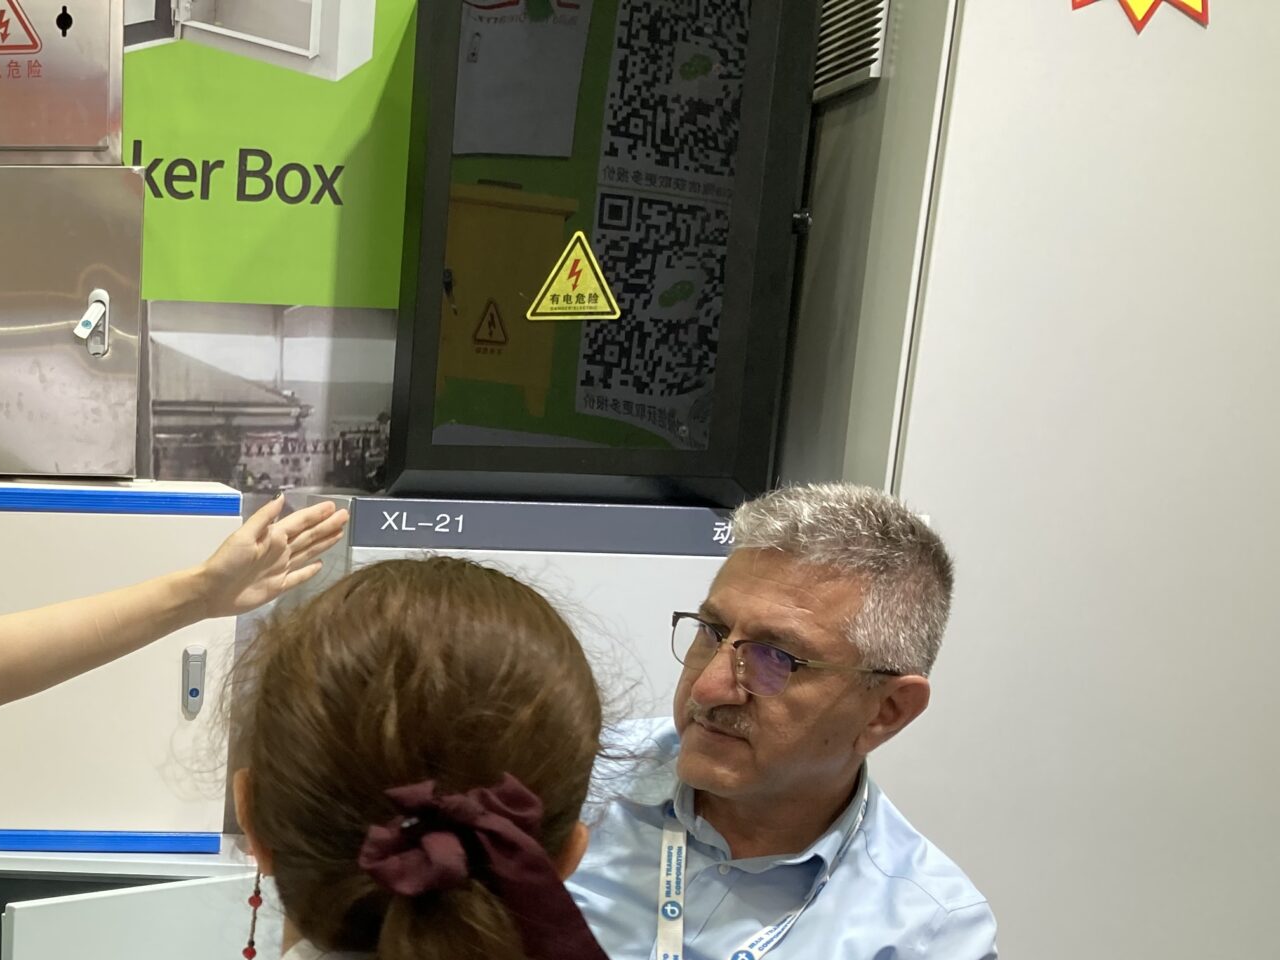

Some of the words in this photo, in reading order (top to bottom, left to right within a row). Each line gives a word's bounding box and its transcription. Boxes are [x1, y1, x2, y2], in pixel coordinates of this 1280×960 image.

[236, 148, 346, 206] Box
[549, 293, 600, 305] 有电危险
[380, 510, 466, 534] XL-21
[666, 845, 674, 877] TRANSFO
[675, 846, 683, 896] CORPORATION
